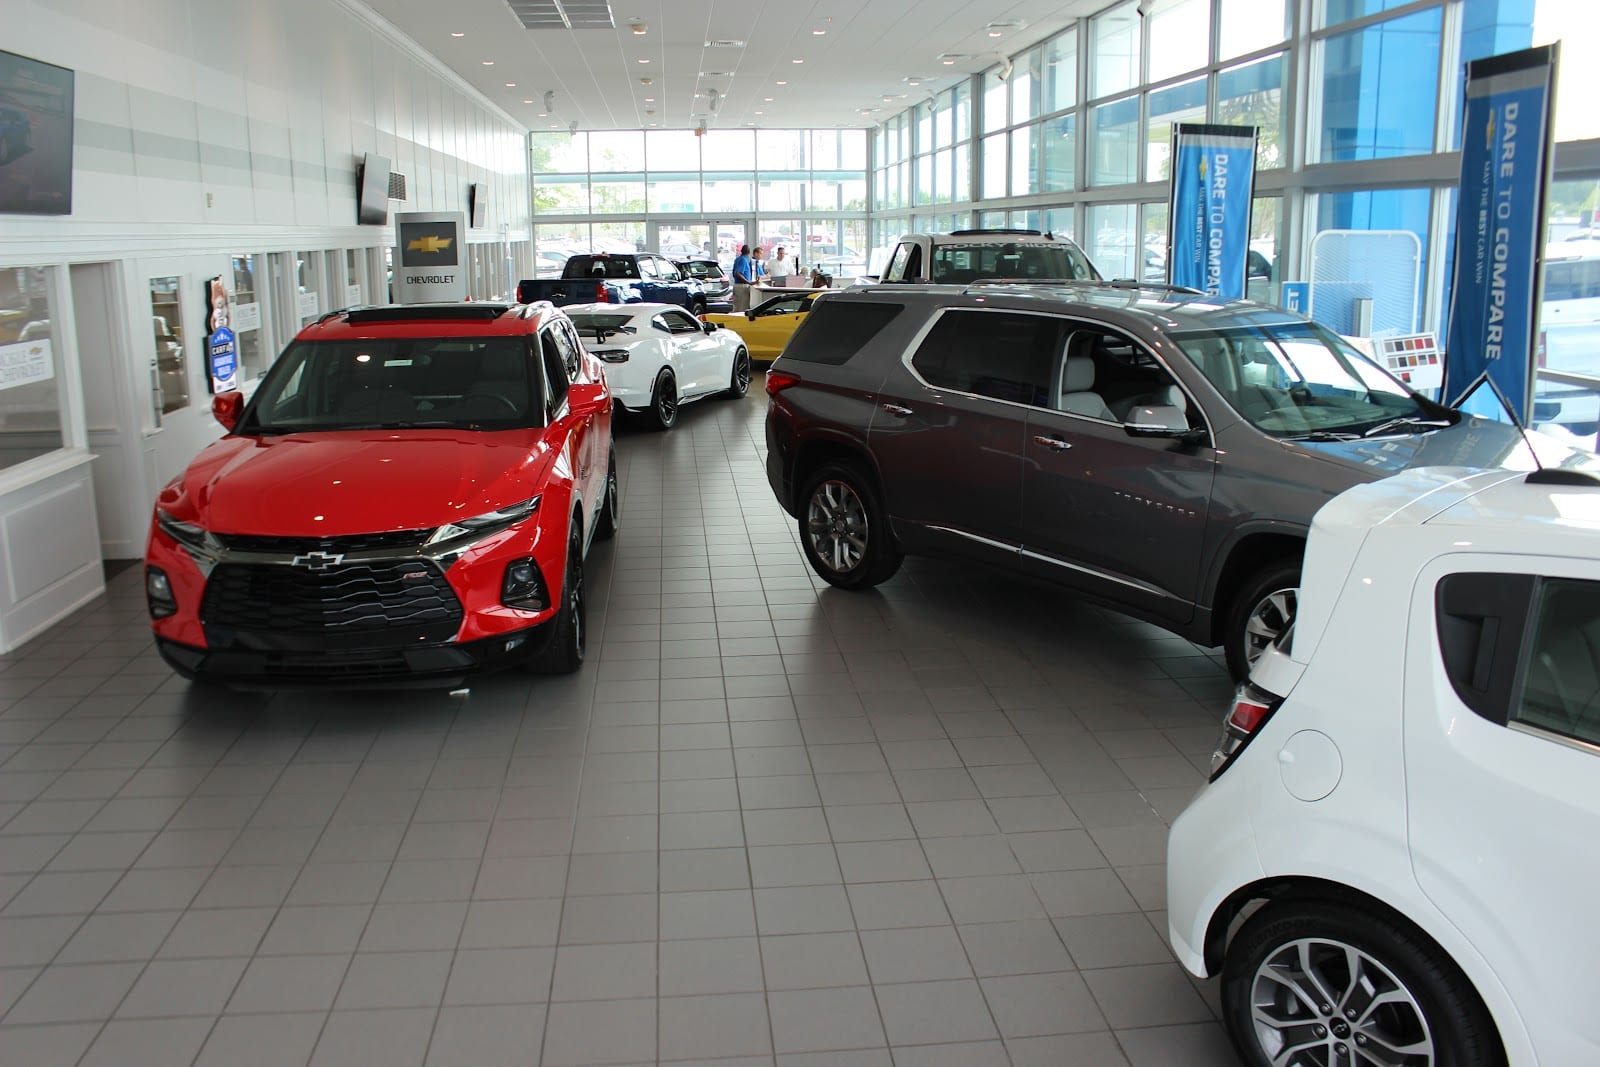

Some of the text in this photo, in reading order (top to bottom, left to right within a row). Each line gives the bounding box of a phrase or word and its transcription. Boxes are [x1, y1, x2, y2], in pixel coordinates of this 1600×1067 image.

[1480, 187, 1489, 208] THE
[1196, 216, 1204, 236] BEST
[1207, 154, 1228, 297] DARE TO COMPAR
[1478, 209, 1487, 236] BEST
[1485, 102, 1518, 360] DARE TO COMPARE
[938, 242, 1006, 251] ROCKY
[1477, 238, 1485, 259] CAR
[406, 275, 455, 285] CHEVROLET
[1475, 261, 1484, 284] WIN
